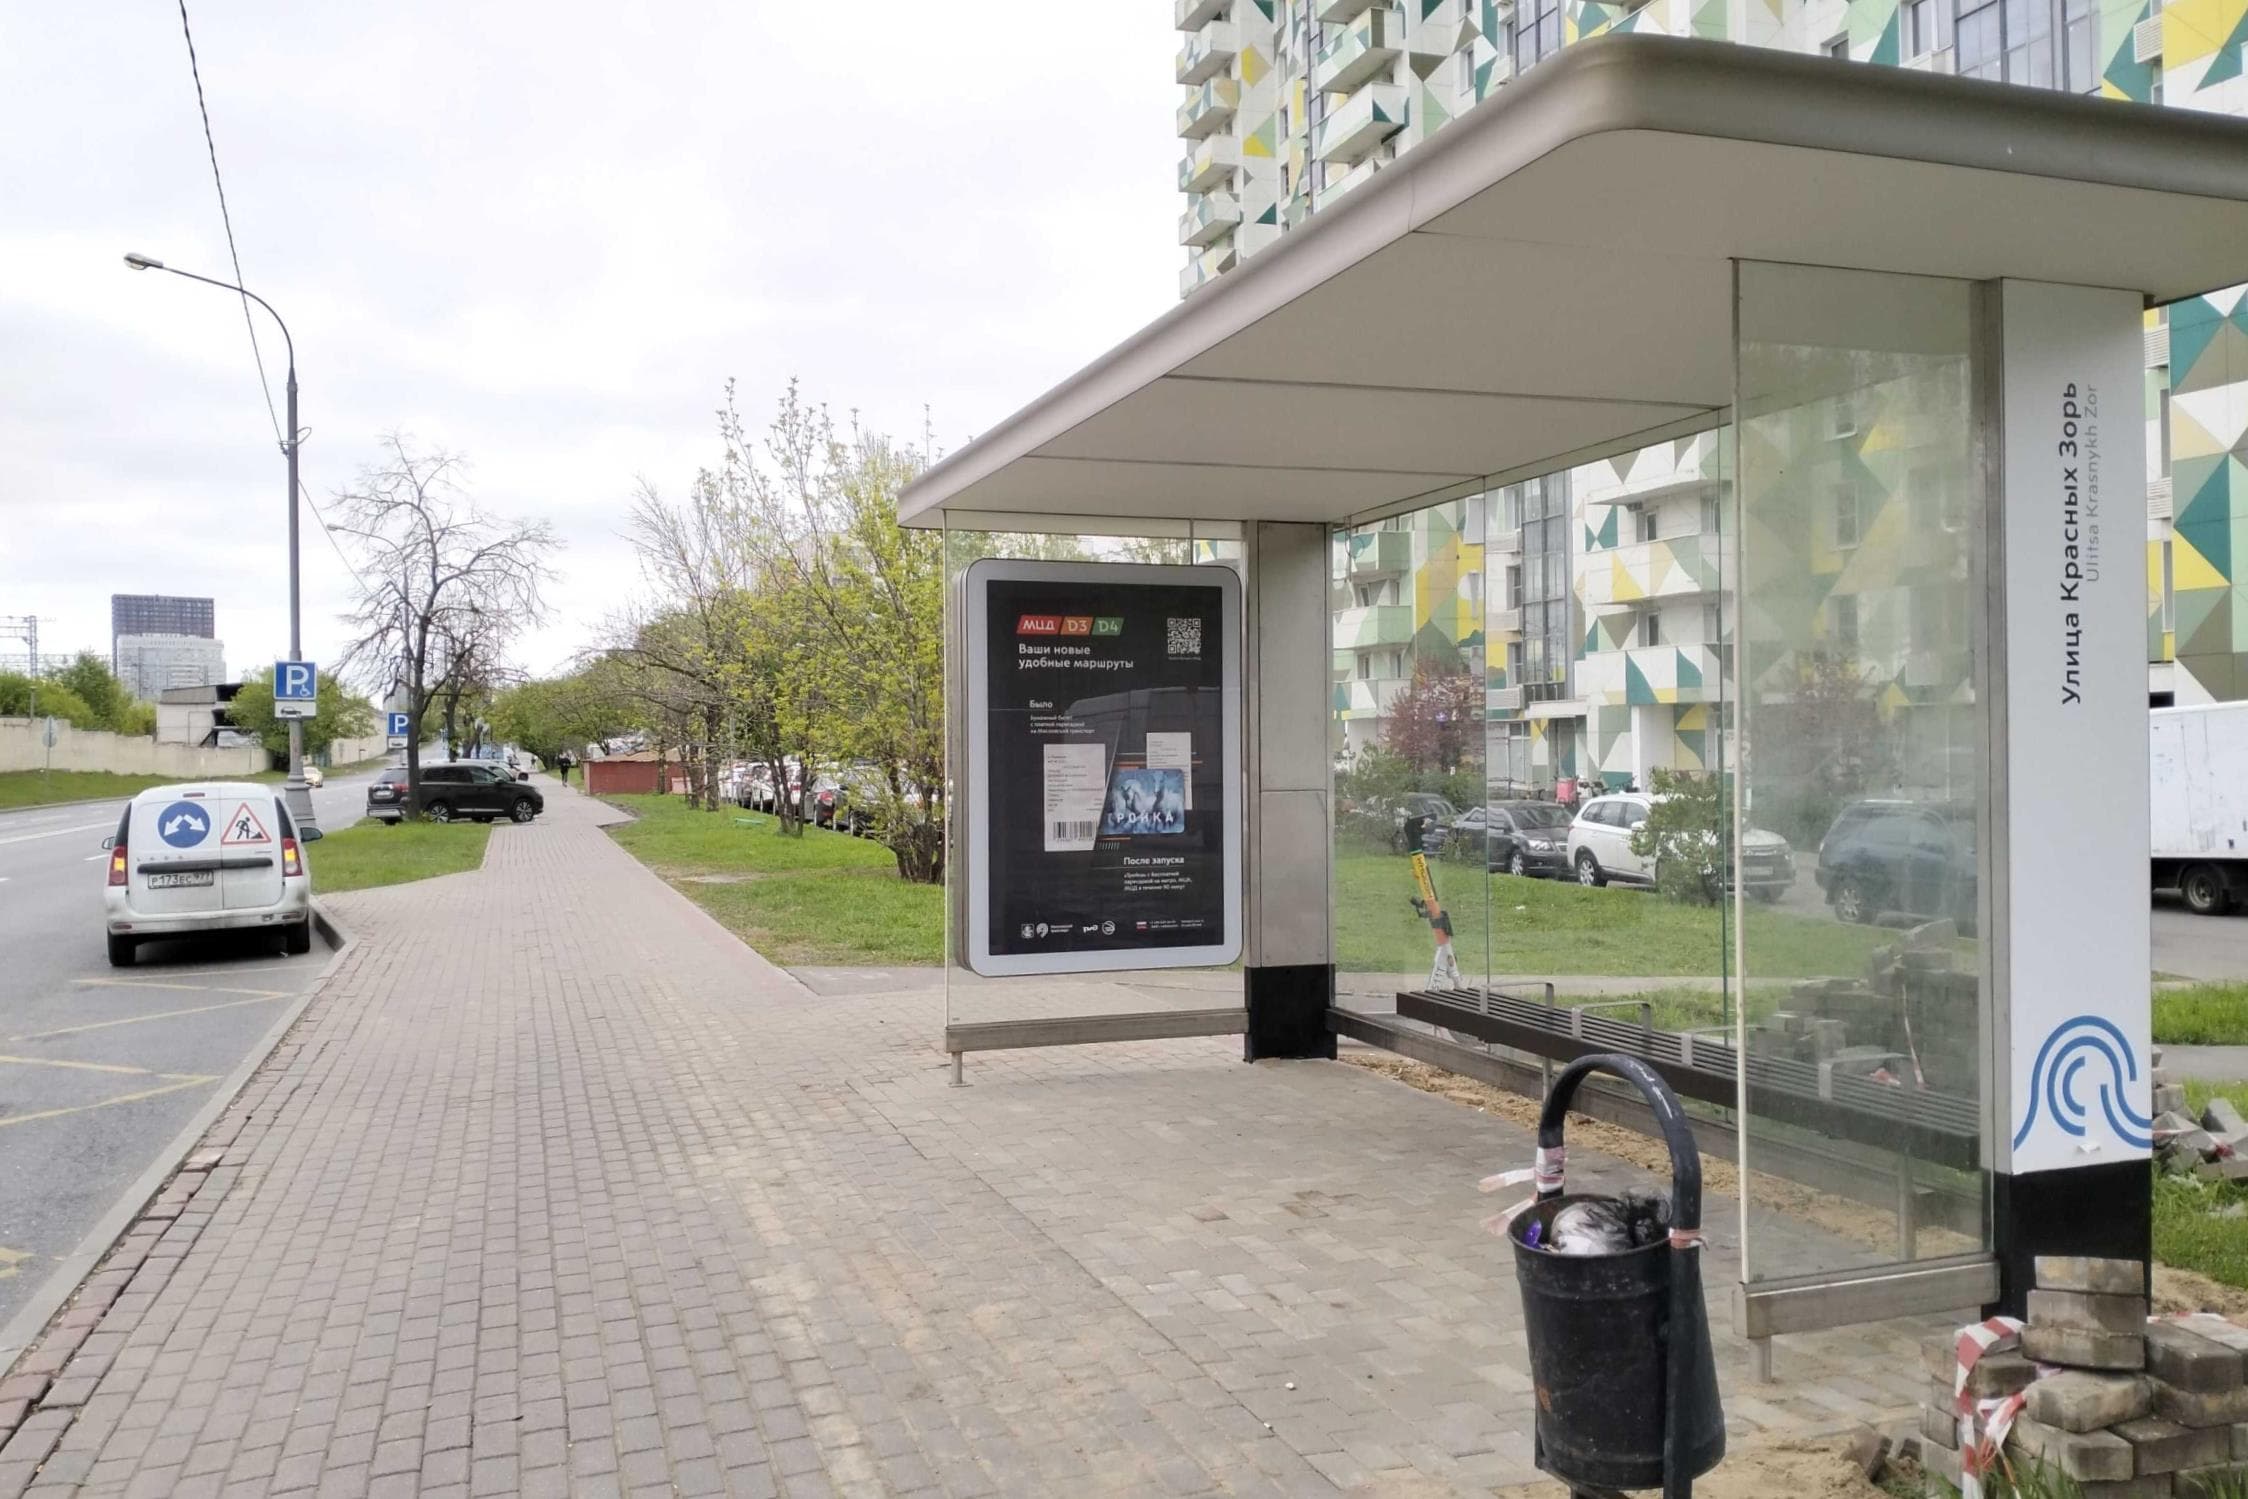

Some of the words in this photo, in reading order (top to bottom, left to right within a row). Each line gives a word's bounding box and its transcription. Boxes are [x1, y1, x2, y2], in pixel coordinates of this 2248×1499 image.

[2084, 384, 2098, 418] Zor
[2059, 382, 2081, 457] Зорь
[2084, 425, 2101, 517] Krasnykh
[2061, 467, 2083, 601] Красных
[2086, 524, 2100, 582] Ulitsa
[1022, 619, 1055, 631] МЦД
[1066, 620, 1088, 632] D3
[1098, 620, 1119, 632] D4
[1018, 643, 1051, 654] Ваши
[1053, 646, 1091, 655] новые
[2062, 613, 2082, 705] Улица
[1018, 657, 1071, 669] удобные
[1073, 659, 1134, 670] маршруты
[1029, 699, 1053, 708] Было
[1123, 857, 1150, 865] После
[1152, 857, 1185, 866] запуска
